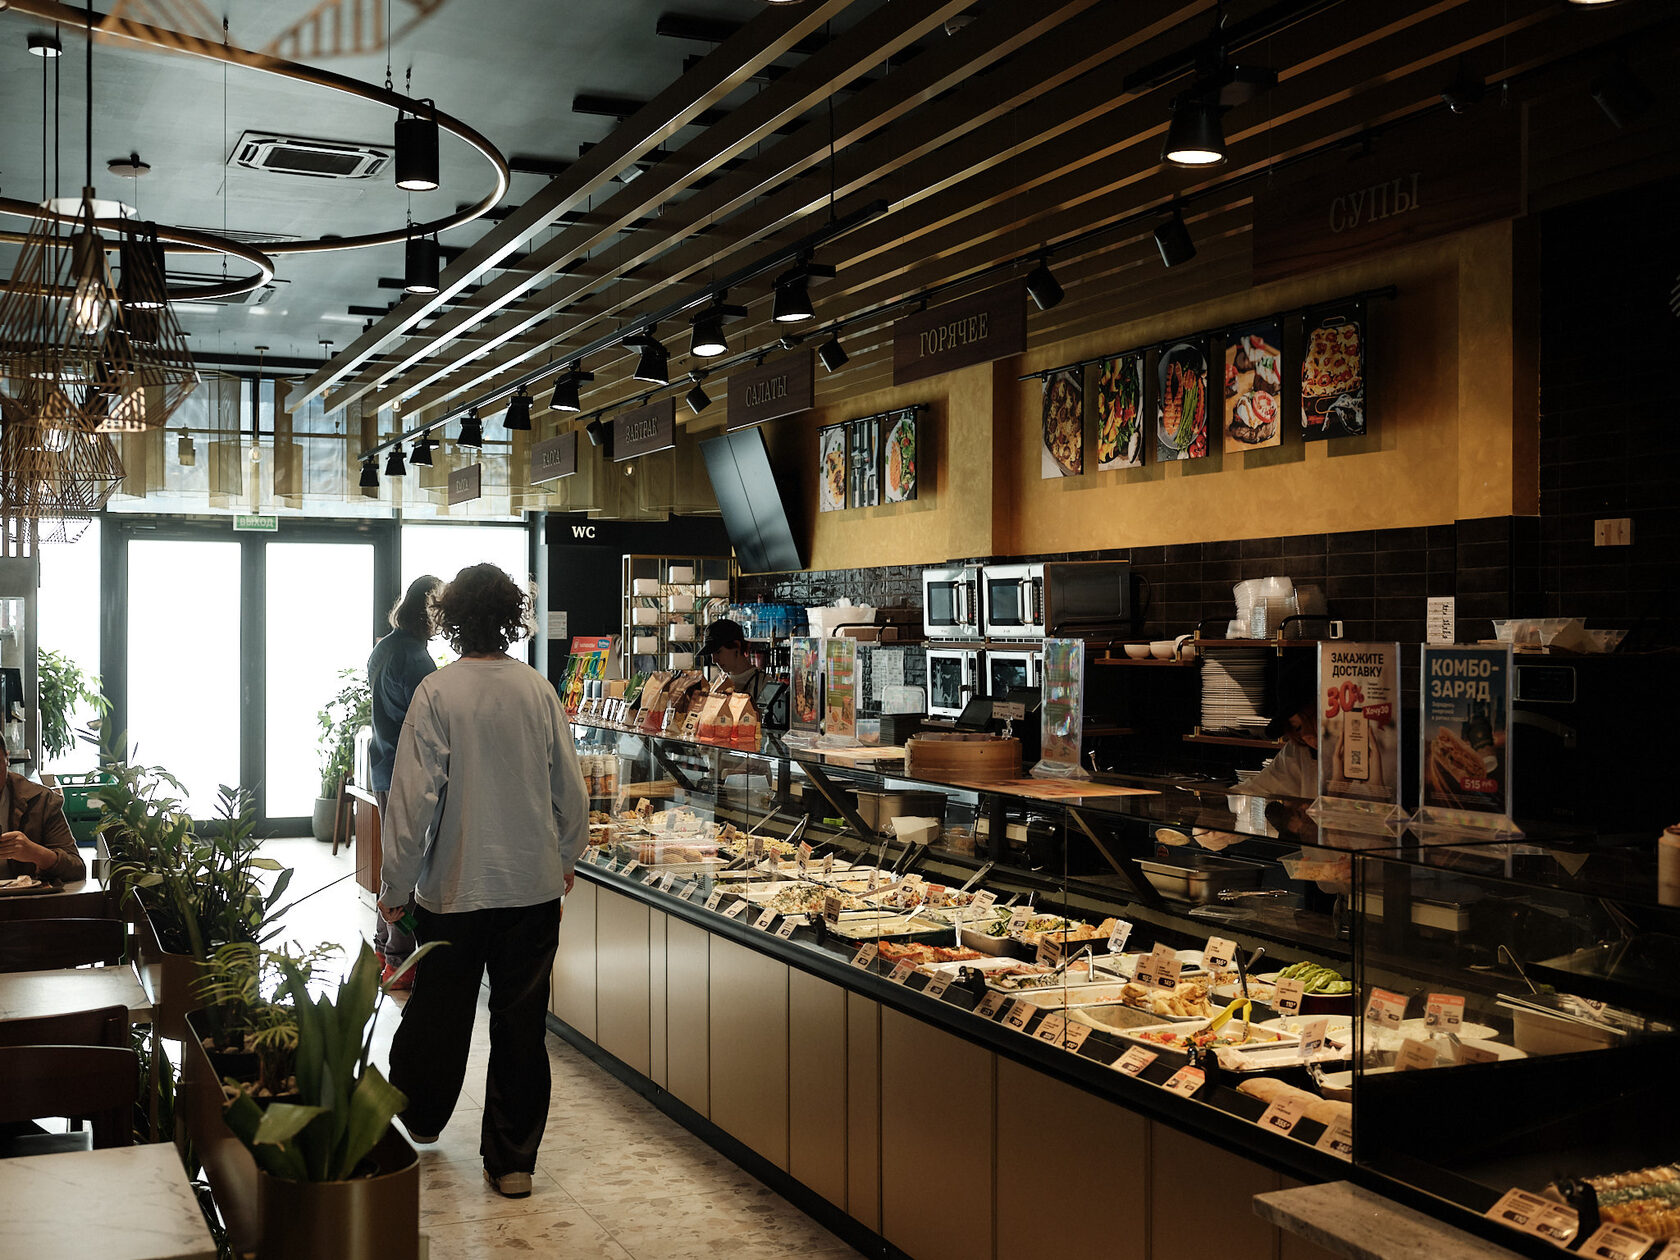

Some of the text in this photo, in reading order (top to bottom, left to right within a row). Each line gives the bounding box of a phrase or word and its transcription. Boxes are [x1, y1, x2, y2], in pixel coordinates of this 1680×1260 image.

[1329, 172, 1423, 233] СУПЫ
[919, 312, 990, 357] ГОРЯЧЕЕ
[745, 375, 788, 407] САЛАТЫ
[625, 416, 658, 443] ЗАВТРАК
[240, 518, 274, 528] ВЫХОД
[571, 525, 596, 539] WC
[1331, 653, 1384, 665] ЗАКАЖИТЕ
[1431, 658, 1500, 678] КОМБО-
[1332, 665, 1382, 678] ДОСТАВКУ
[1325, 681, 1365, 719] 30%
[1431, 679, 1491, 703] ЗАРЯД
[1464, 779, 1480, 790] 515
